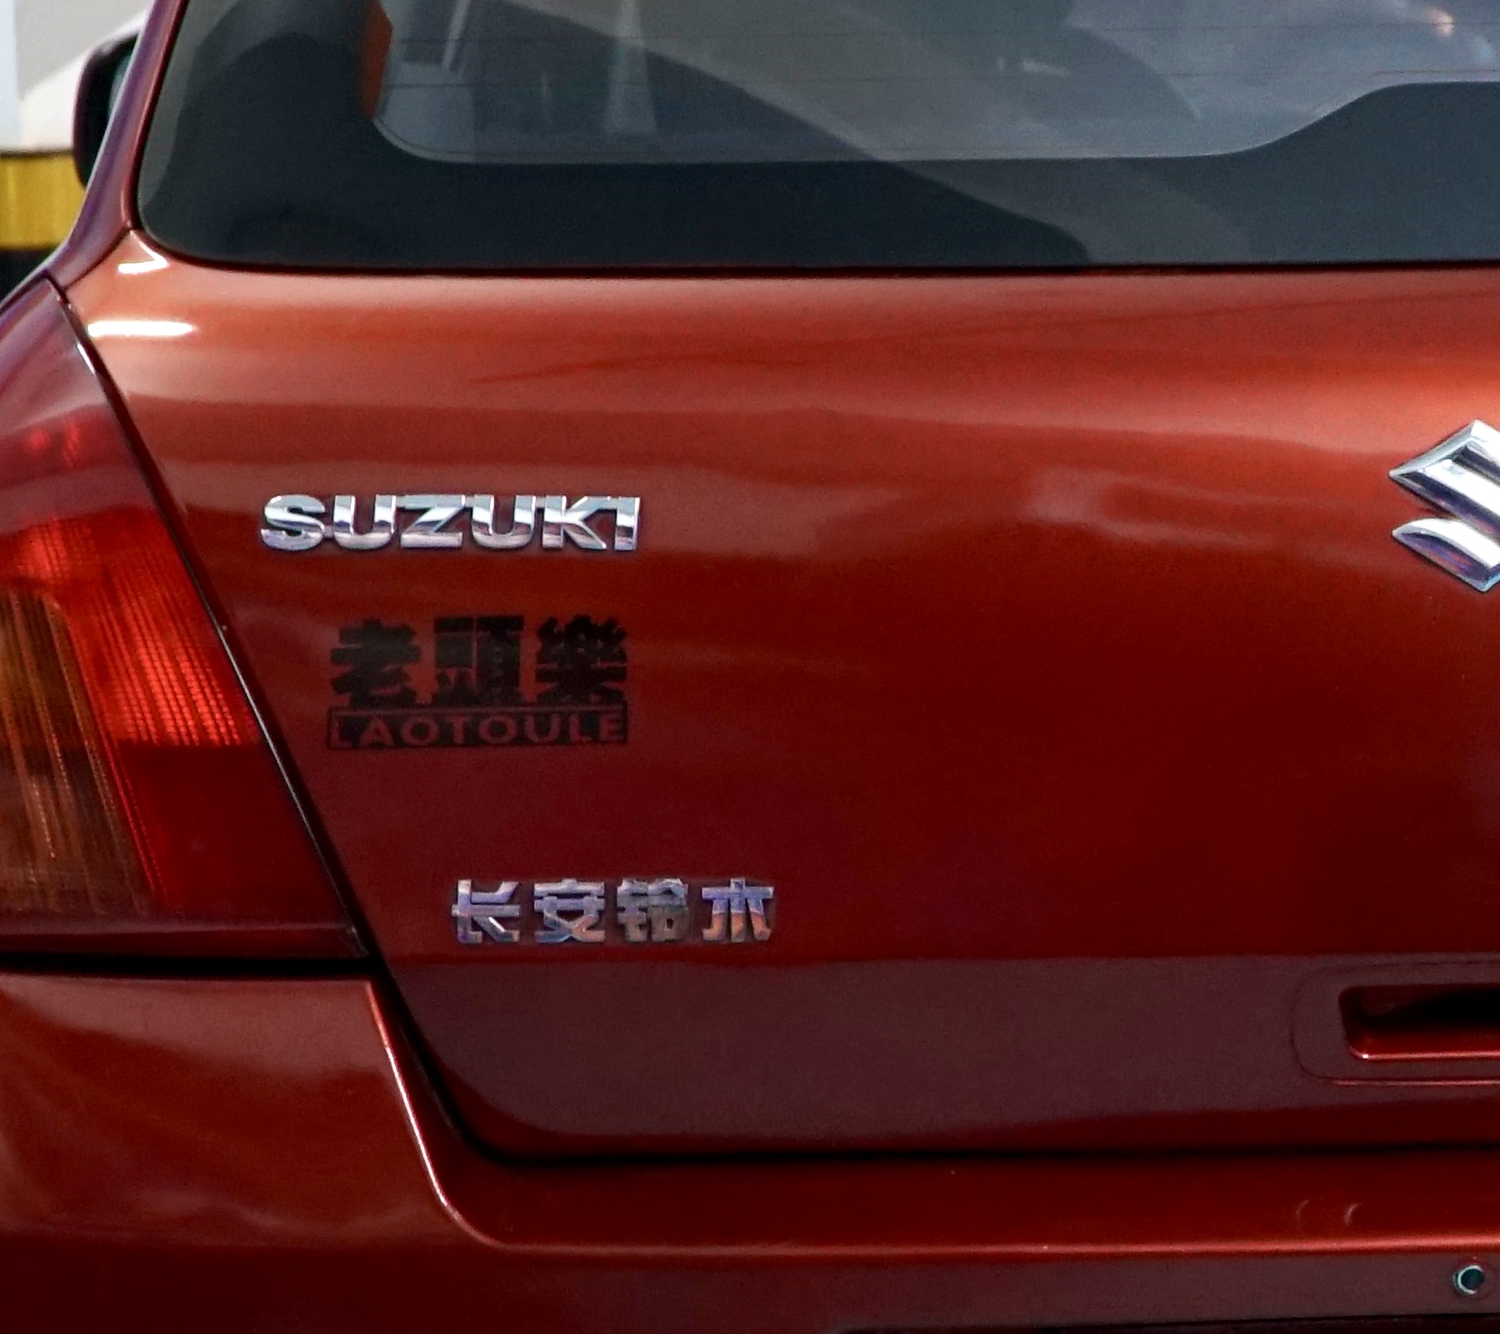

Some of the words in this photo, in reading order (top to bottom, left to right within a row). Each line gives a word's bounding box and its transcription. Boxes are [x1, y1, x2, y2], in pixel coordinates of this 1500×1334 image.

[260, 493, 642, 552] SUZUKI
[332, 713, 625, 748] LAOTOULE
[451, 877, 776, 945] 长安铃木
